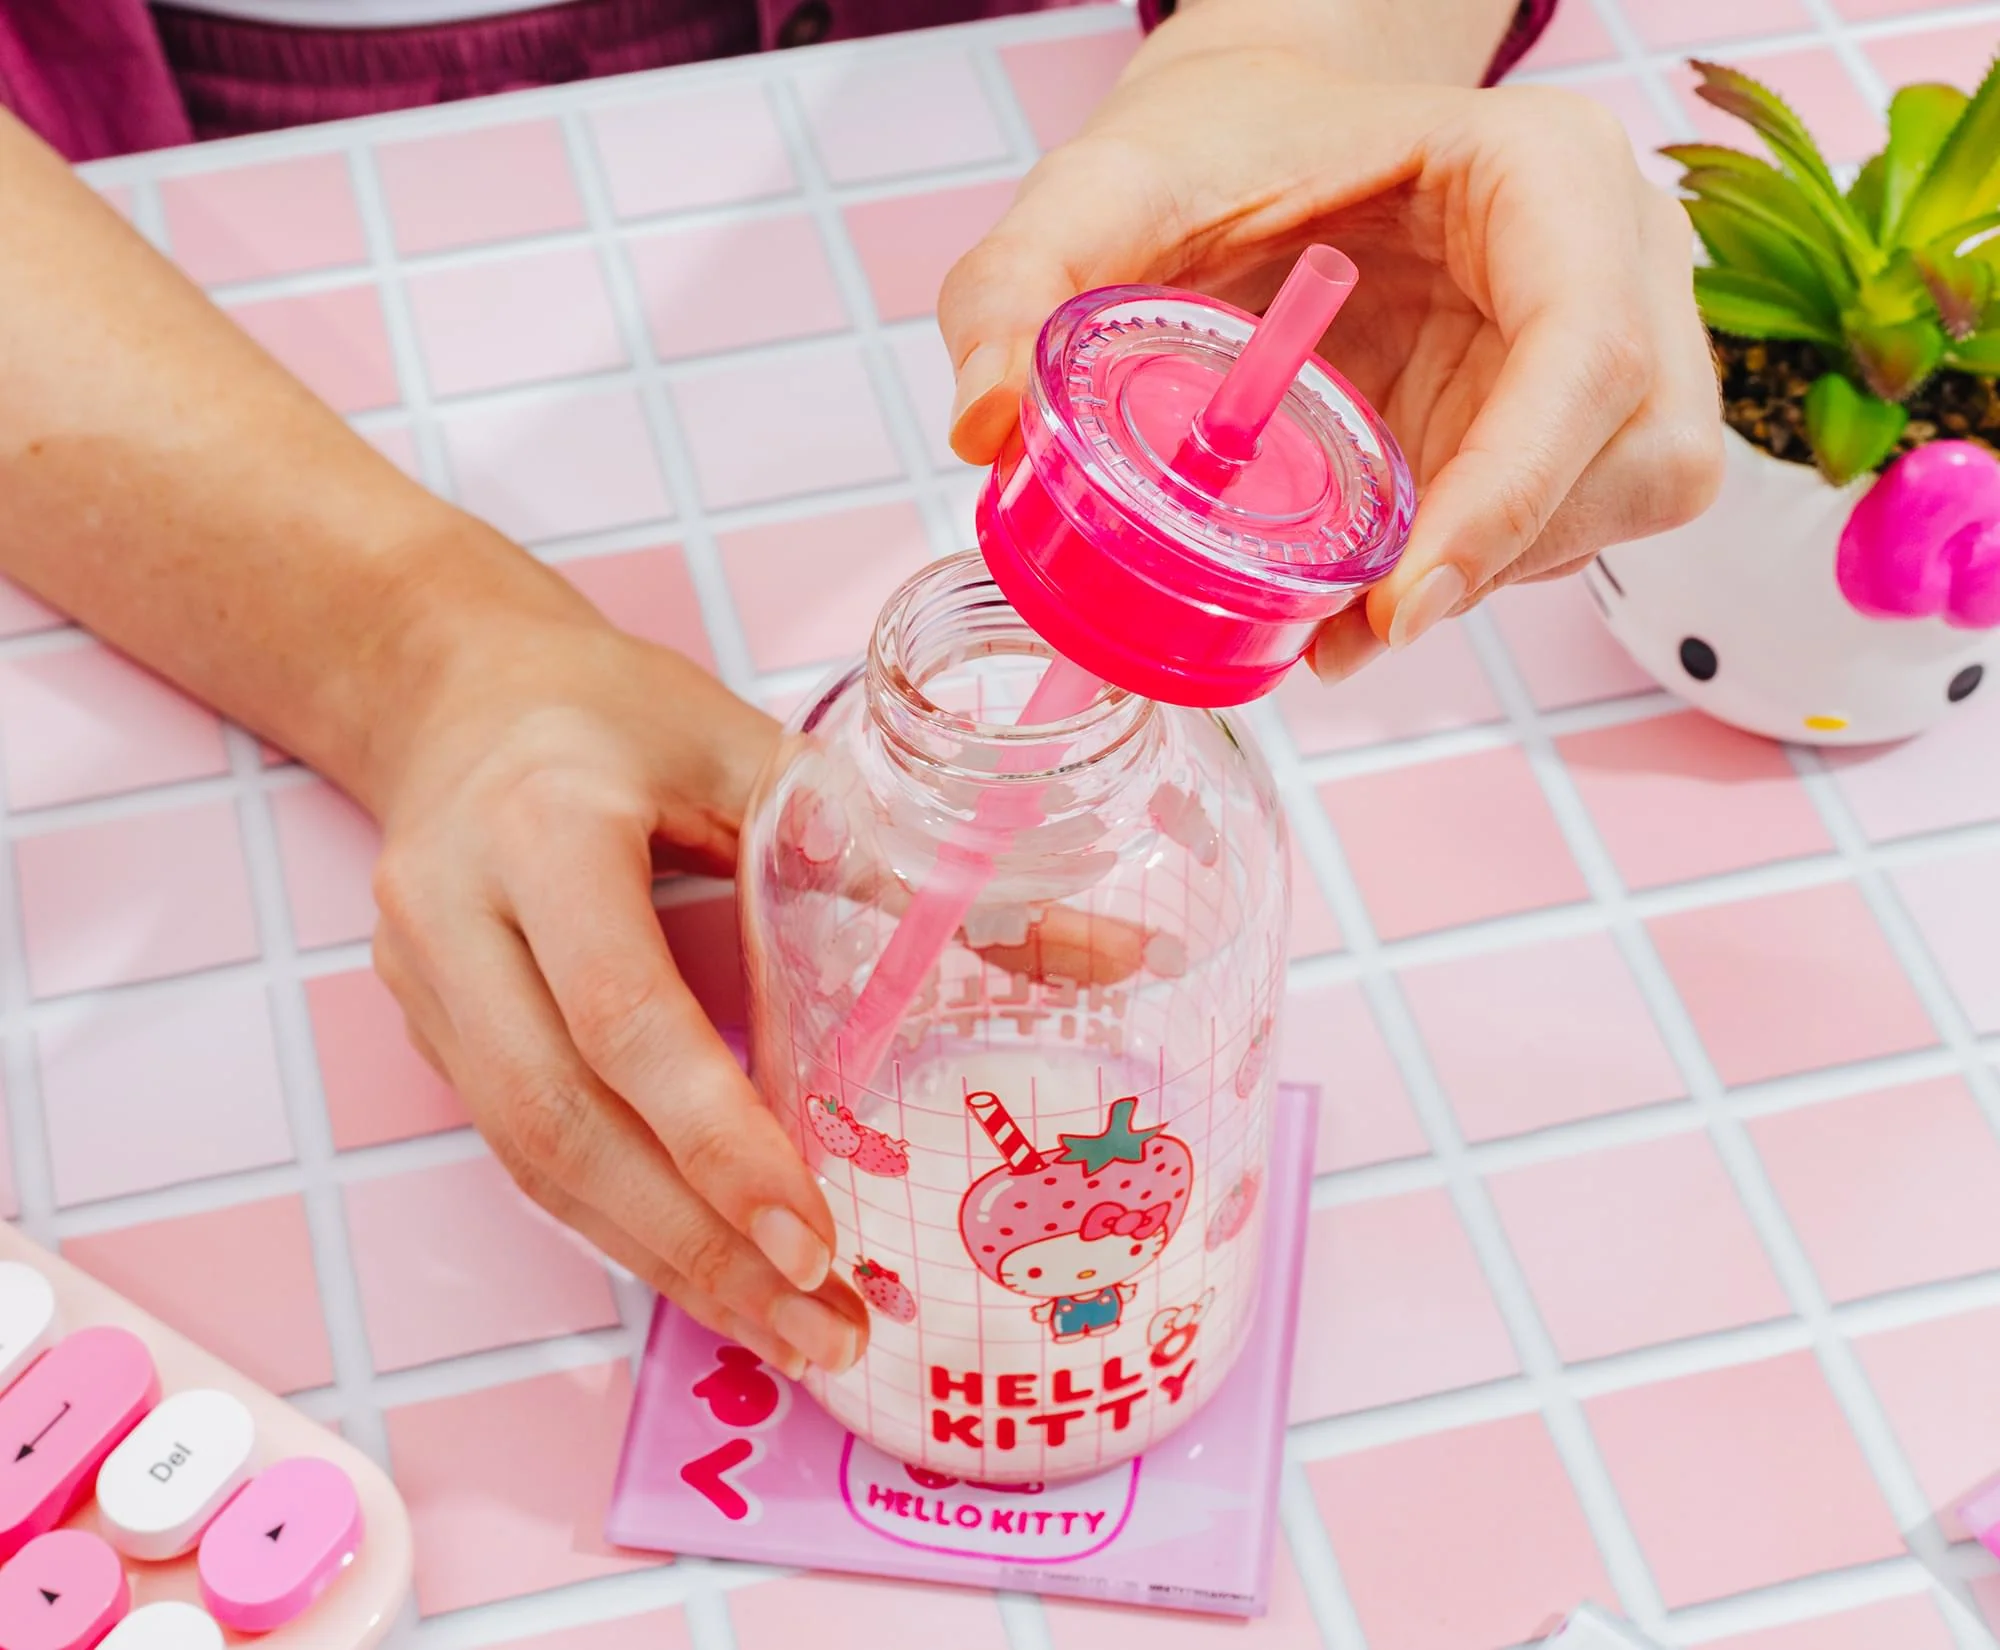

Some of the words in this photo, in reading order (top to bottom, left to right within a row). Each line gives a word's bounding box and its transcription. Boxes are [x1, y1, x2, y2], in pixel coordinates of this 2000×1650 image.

[930, 1324, 1199, 1407] HELLO
[931, 1358, 1197, 1451] KITTY
[149, 1442, 192, 1483] Del
[867, 1484, 982, 1528] HELLO
[991, 1509, 1105, 1535] KITTY
